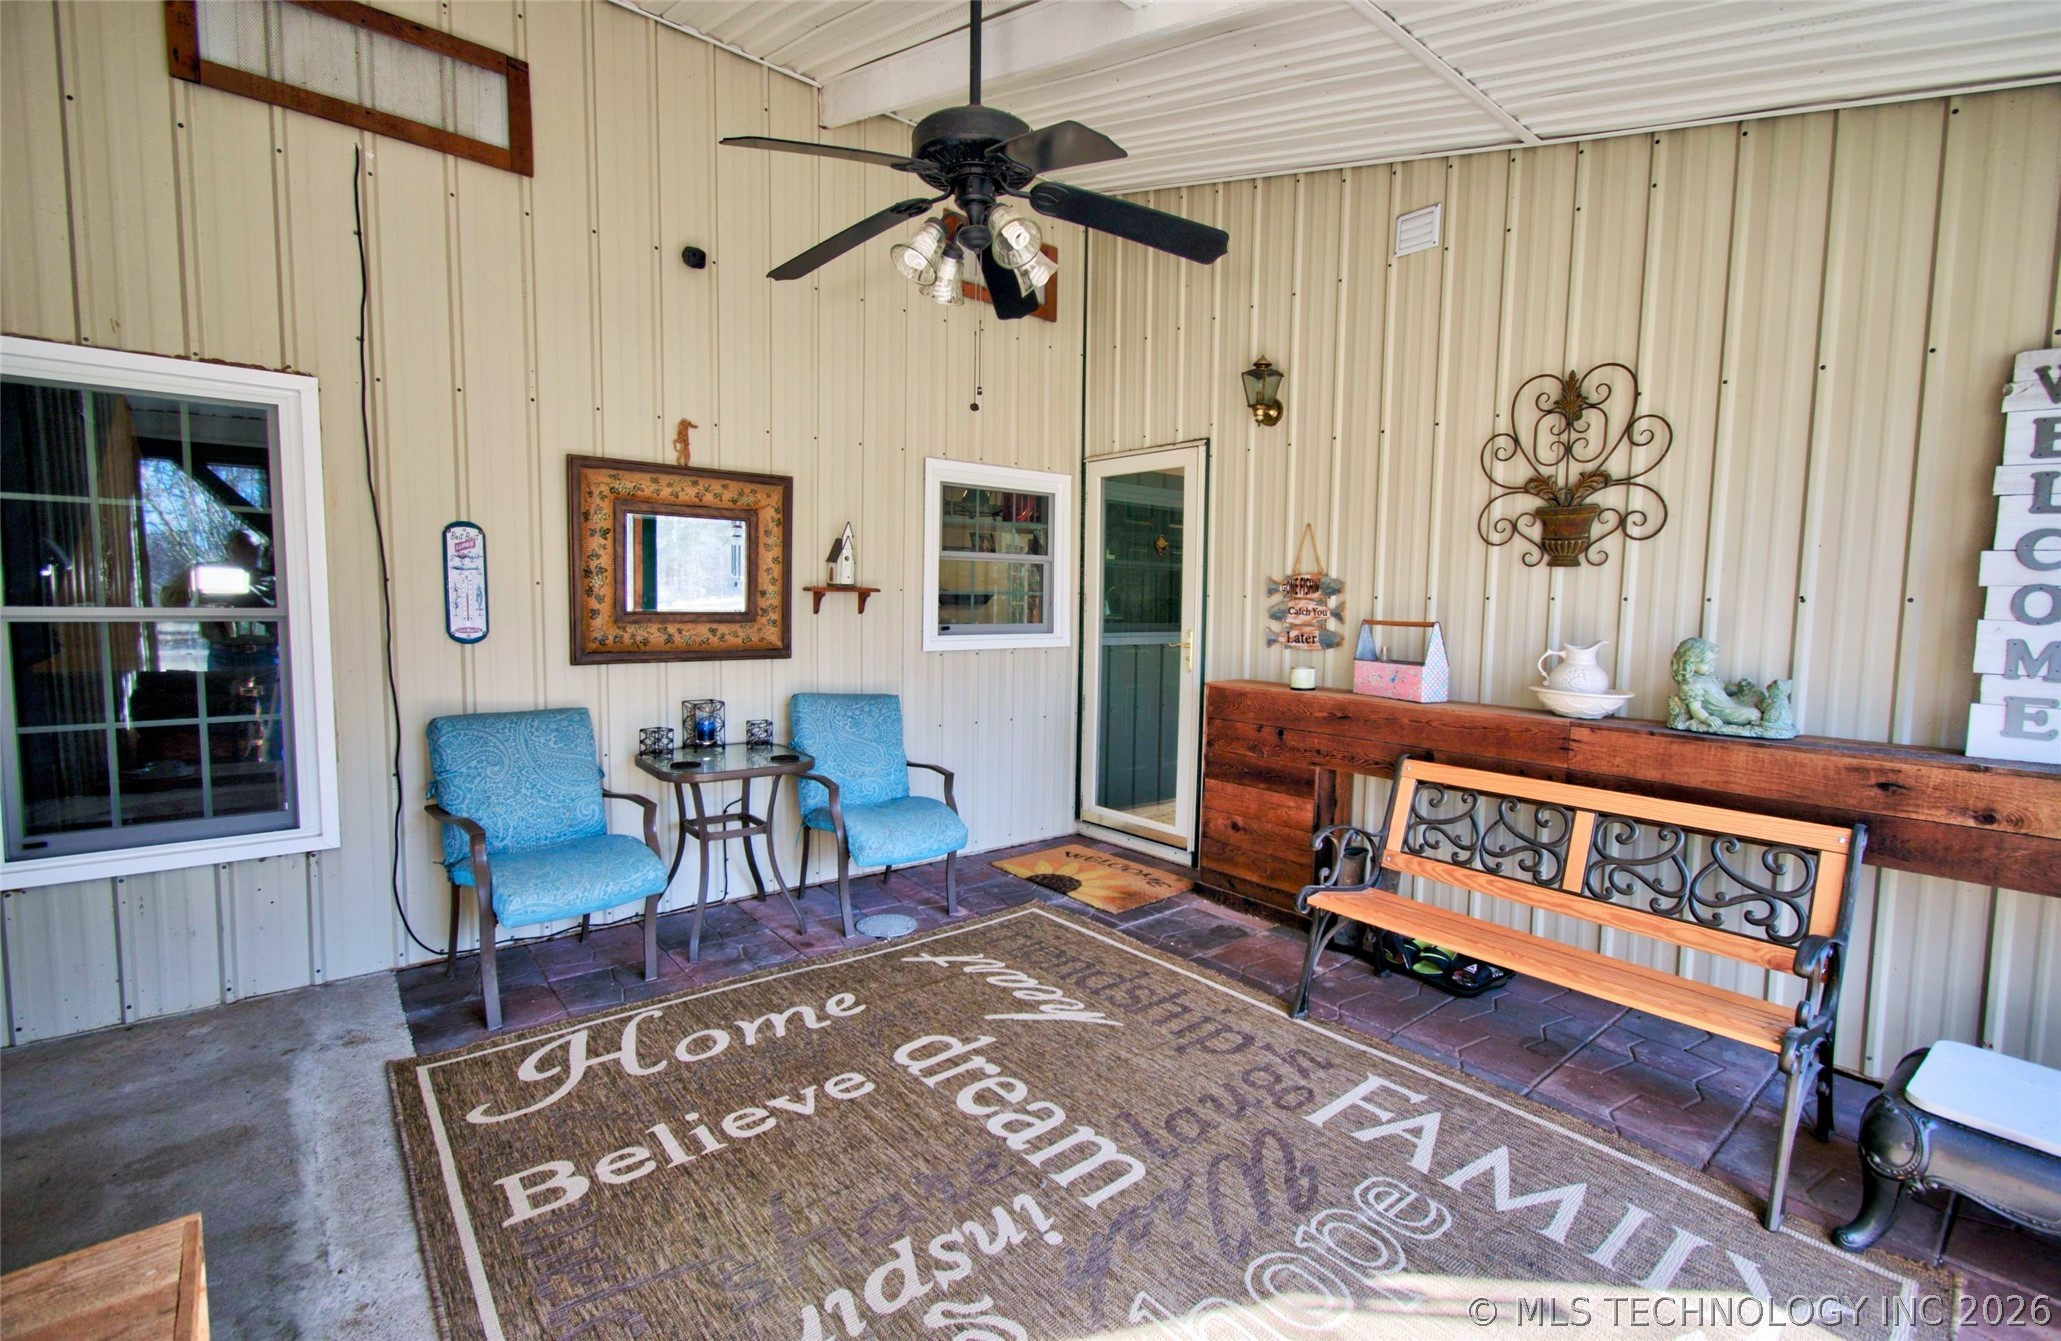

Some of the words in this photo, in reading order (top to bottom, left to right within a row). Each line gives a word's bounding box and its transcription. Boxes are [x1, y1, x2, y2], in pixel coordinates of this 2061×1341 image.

[1286, 630, 1317, 644] Later
[1288, 607, 1311, 616] Catch
[1312, 608, 1328, 618] You
[1063, 851, 1172, 889] WELCOME
[465, 992, 866, 1124] Home
[1114, 1042, 1335, 1161] laugh
[493, 1072, 875, 1227] Believe
[894, 1034, 1146, 1210] dream
[1109, 1176, 1452, 1341] hope
